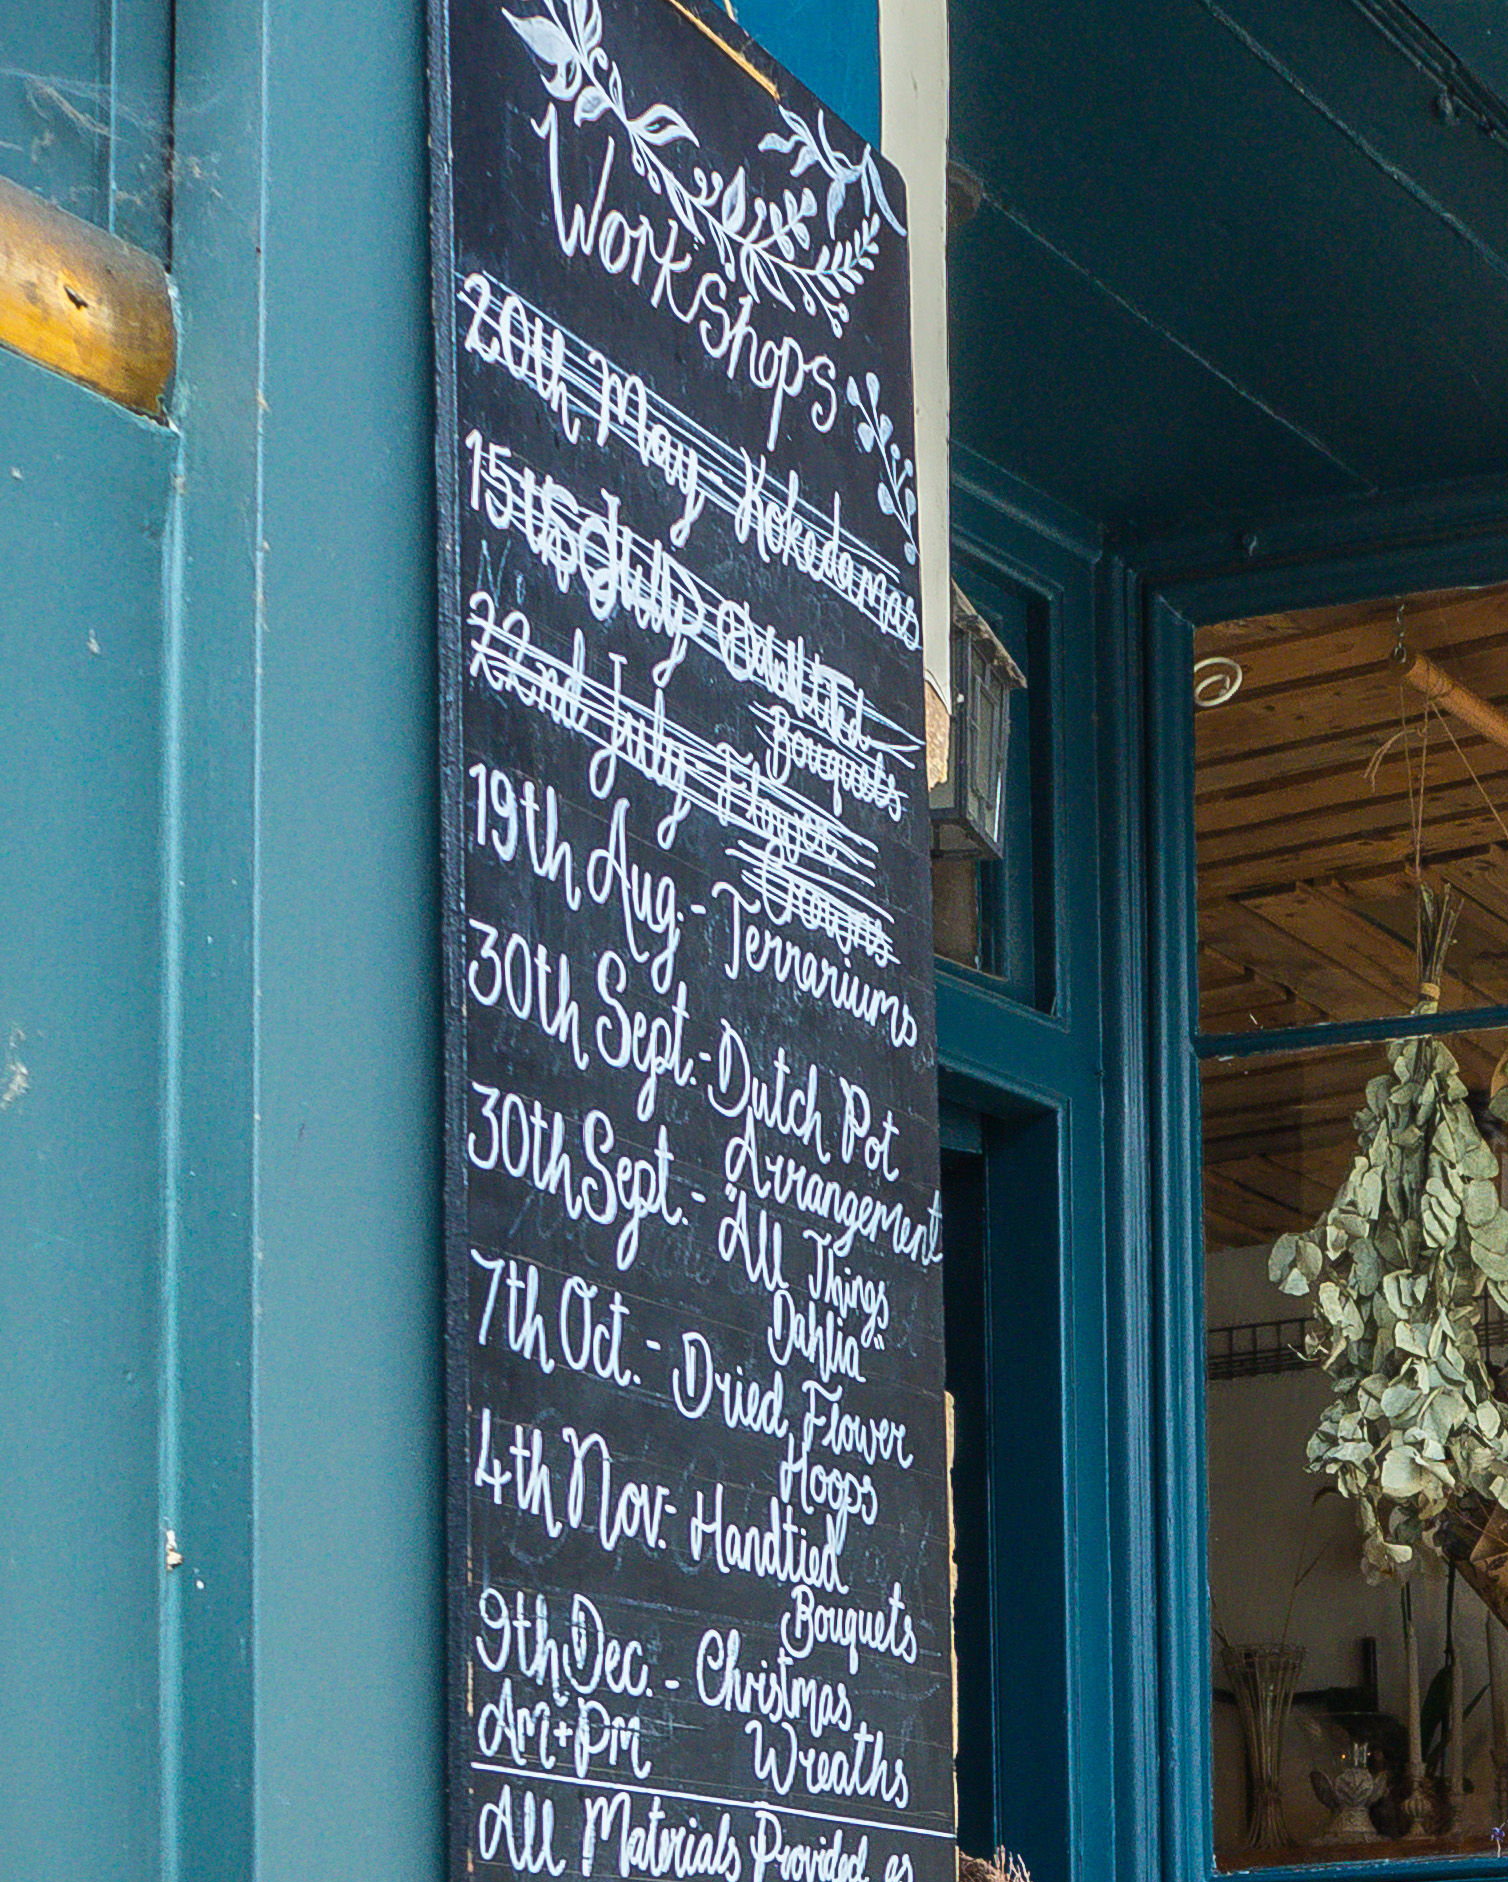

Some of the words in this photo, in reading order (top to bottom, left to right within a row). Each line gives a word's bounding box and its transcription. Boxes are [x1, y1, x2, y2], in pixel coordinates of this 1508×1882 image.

[463, 273, 580, 444] 20th
[590, 350, 706, 547] May
[469, 763, 581, 910] 19th
[711, 882, 918, 1048] Terrariums
[468, 918, 588, 1070] 30th
[596, 950, 697, 1121] Sept.
[708, 1018, 830, 1164] Dutch
[840, 1077, 900, 1182] Pot
[467, 1081, 581, 1220] 30th
[725, 1105, 944, 1265] Arrangement
[470, 1247, 555, 1374] 7th
[560, 1277, 643, 1385] Oct.
[673, 1332, 790, 1438] Dried
[801, 1380, 915, 1468] Flower
[803, 1230, 890, 1339] Things
[474, 1408, 562, 1538] 4th
[690, 1482, 849, 1594] Handtied
[780, 1434, 878, 1555] Hoops
[476, 1587, 570, 1706] 9th
[565, 1594, 653, 1697] Dec.
[696, 1628, 852, 1737] Christmas
[782, 1582, 917, 1674] Bouquets
[479, 1784, 566, 1877] All
[746, 1720, 909, 1808] Wreaths
